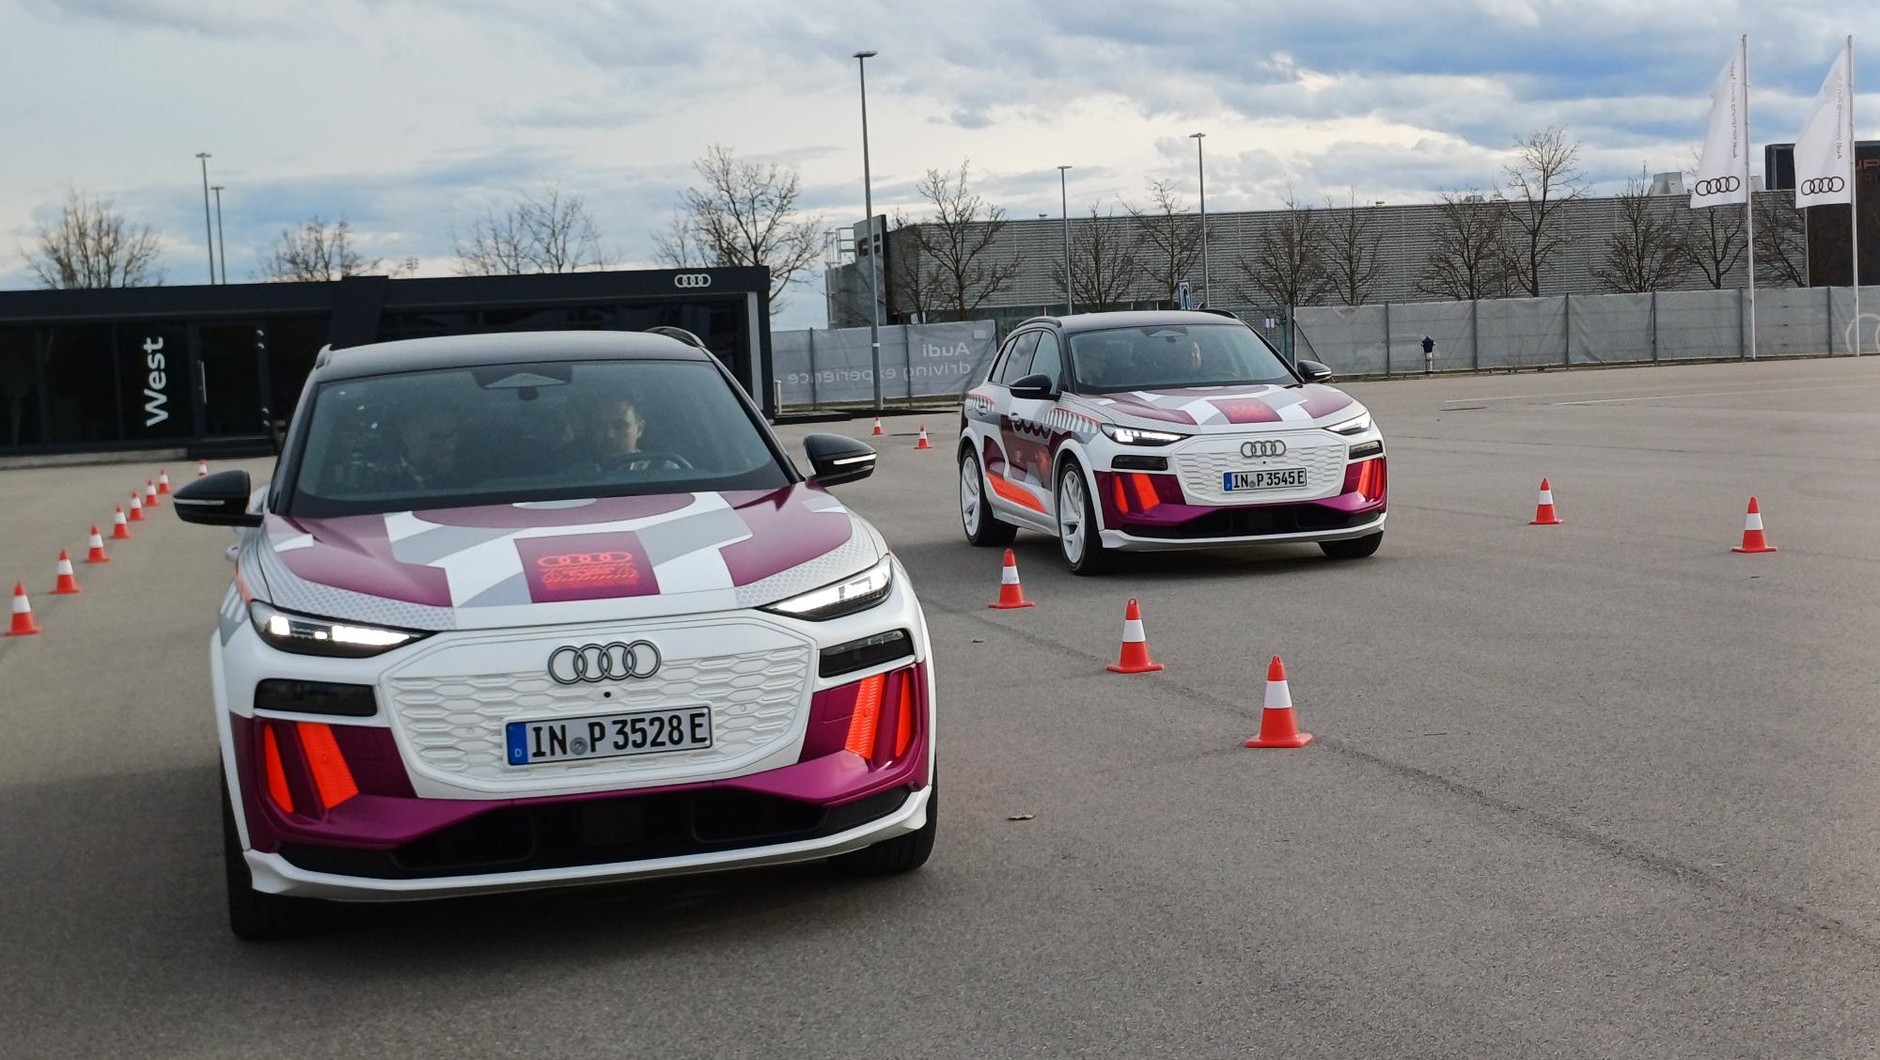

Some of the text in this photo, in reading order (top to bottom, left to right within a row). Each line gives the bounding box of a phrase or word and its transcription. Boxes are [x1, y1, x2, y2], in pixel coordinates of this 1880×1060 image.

[143, 336, 169, 427] West
[1234, 474, 1249, 488] IN
[514, 749, 521, 757] D
[532, 724, 568, 757] IN
[588, 722, 606, 752] P
